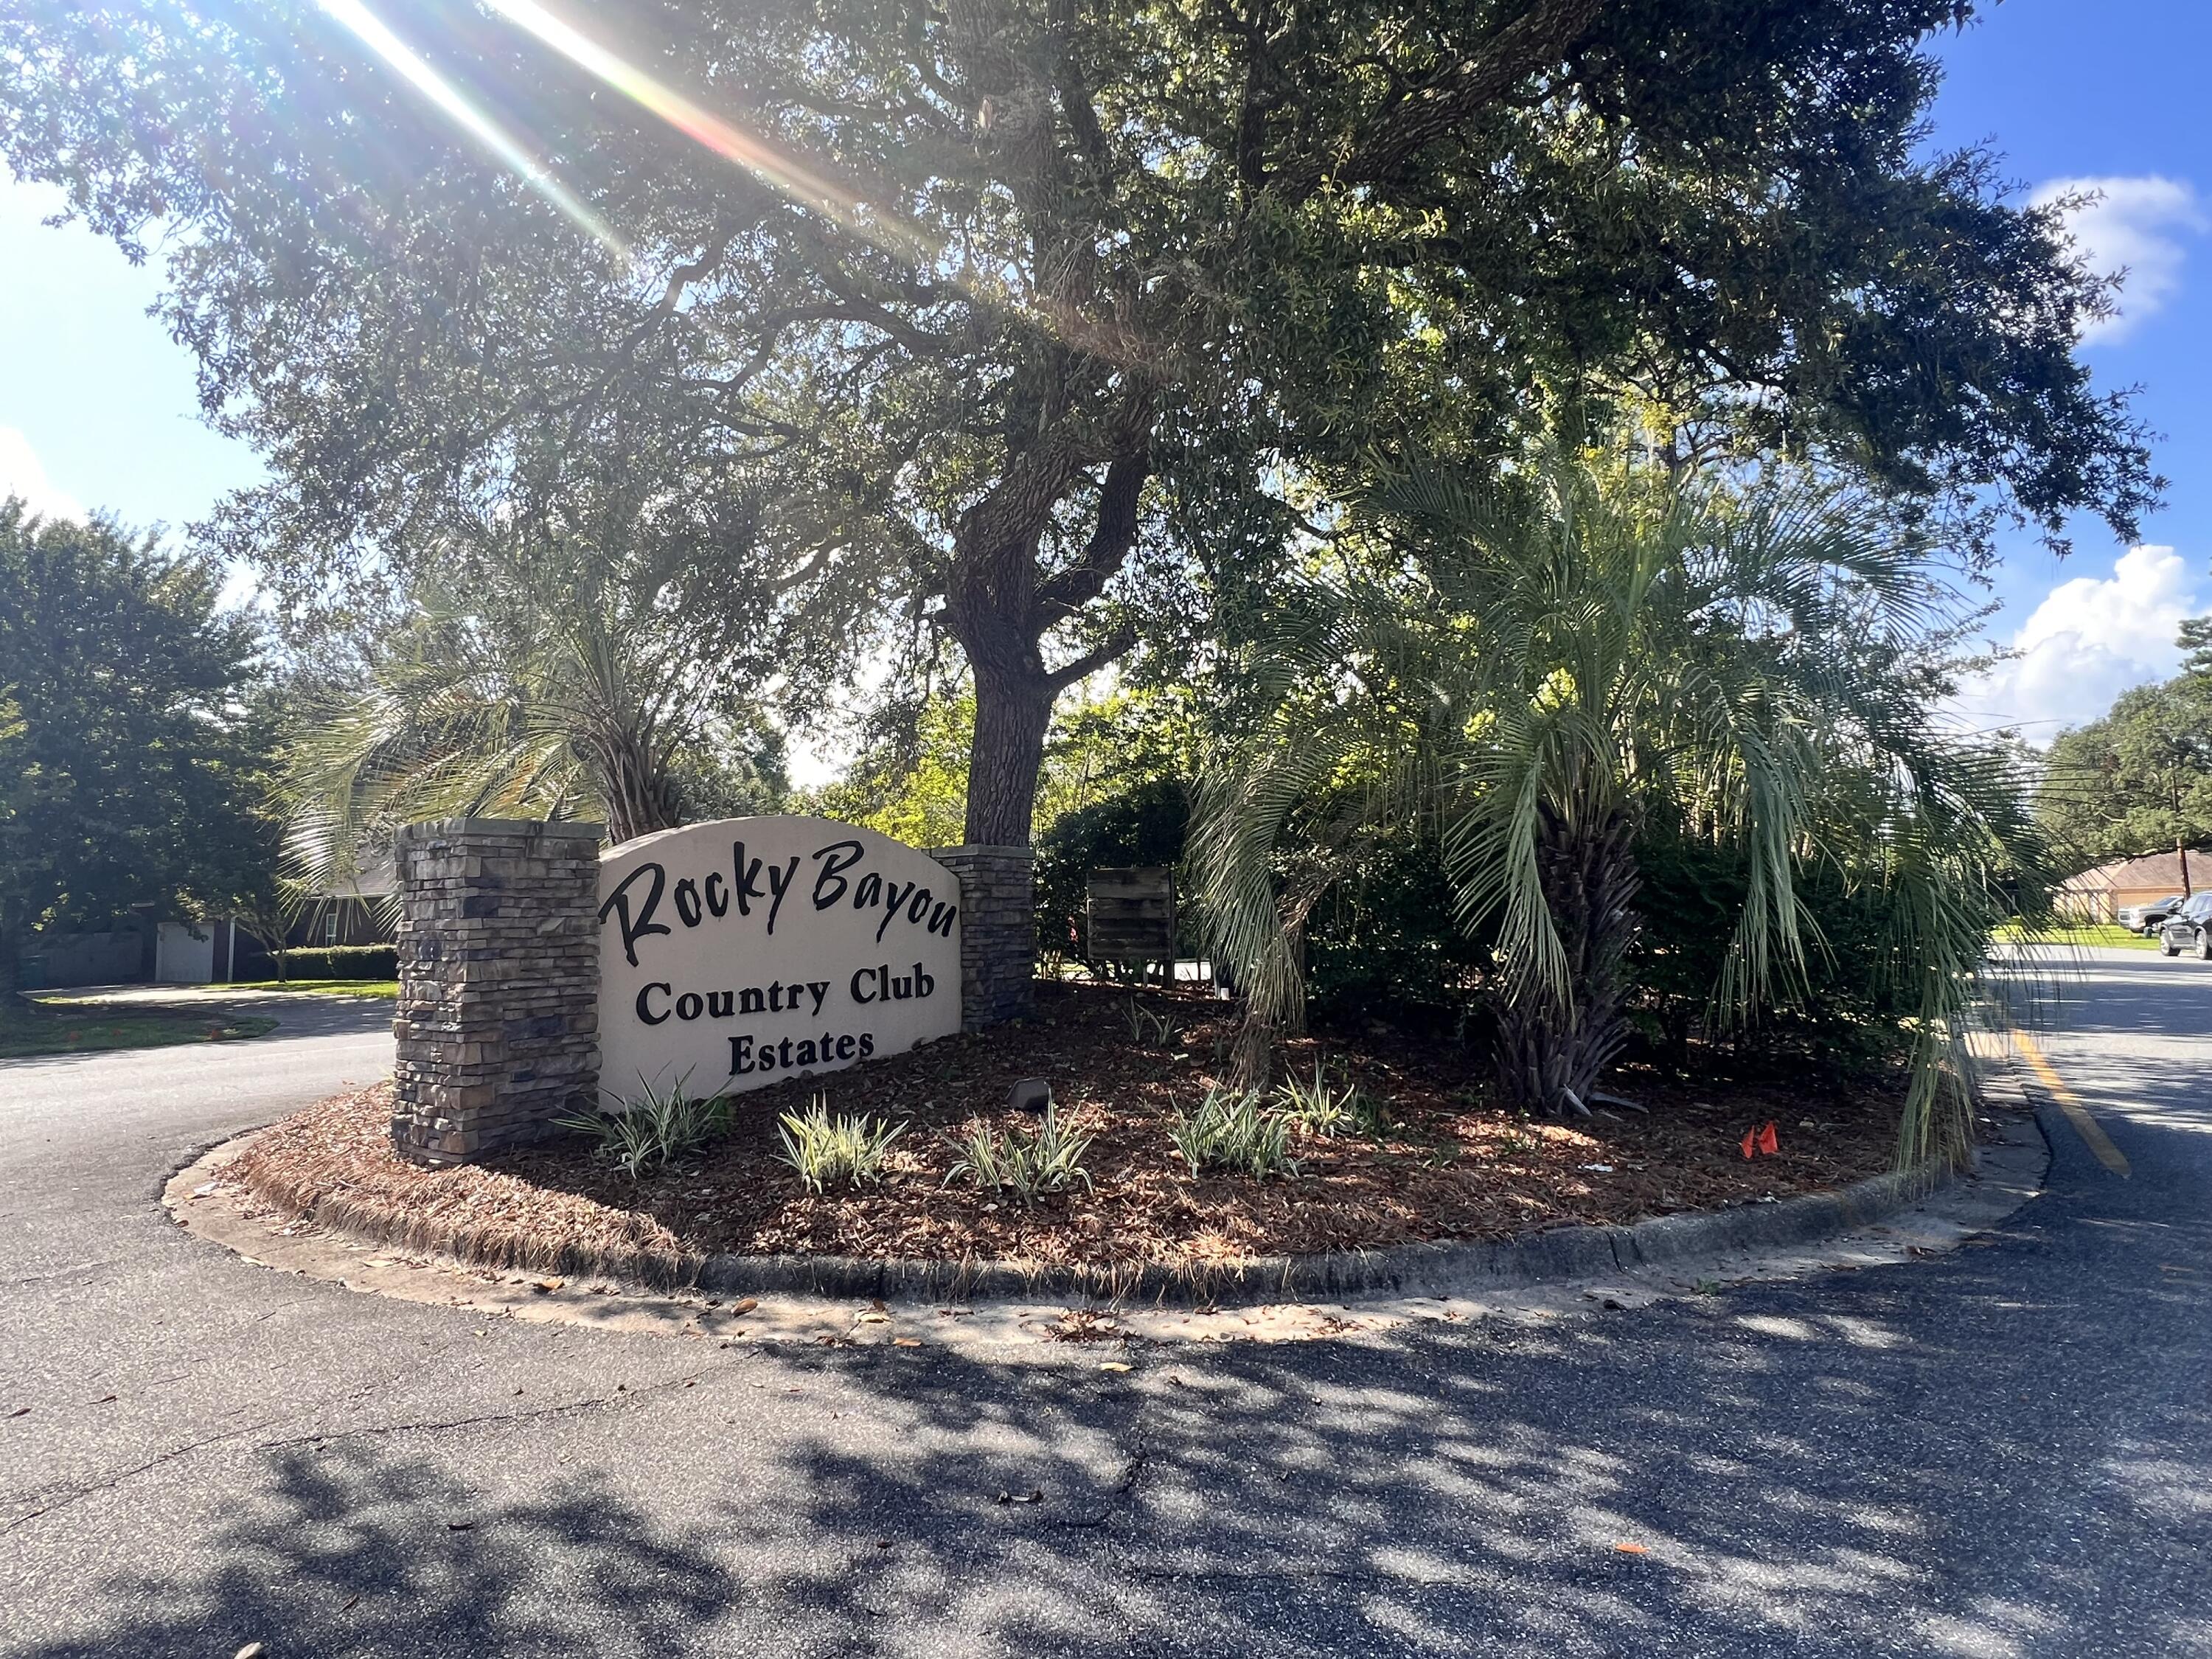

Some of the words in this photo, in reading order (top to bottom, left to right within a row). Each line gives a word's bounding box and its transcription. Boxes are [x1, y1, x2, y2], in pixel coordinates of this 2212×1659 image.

[597, 841, 800, 967] Rocky
[812, 840, 957, 943] Bayou
[636, 980, 830, 1025] Country
[850, 962, 935, 1004] Club
[728, 1032, 874, 1076] Estates
